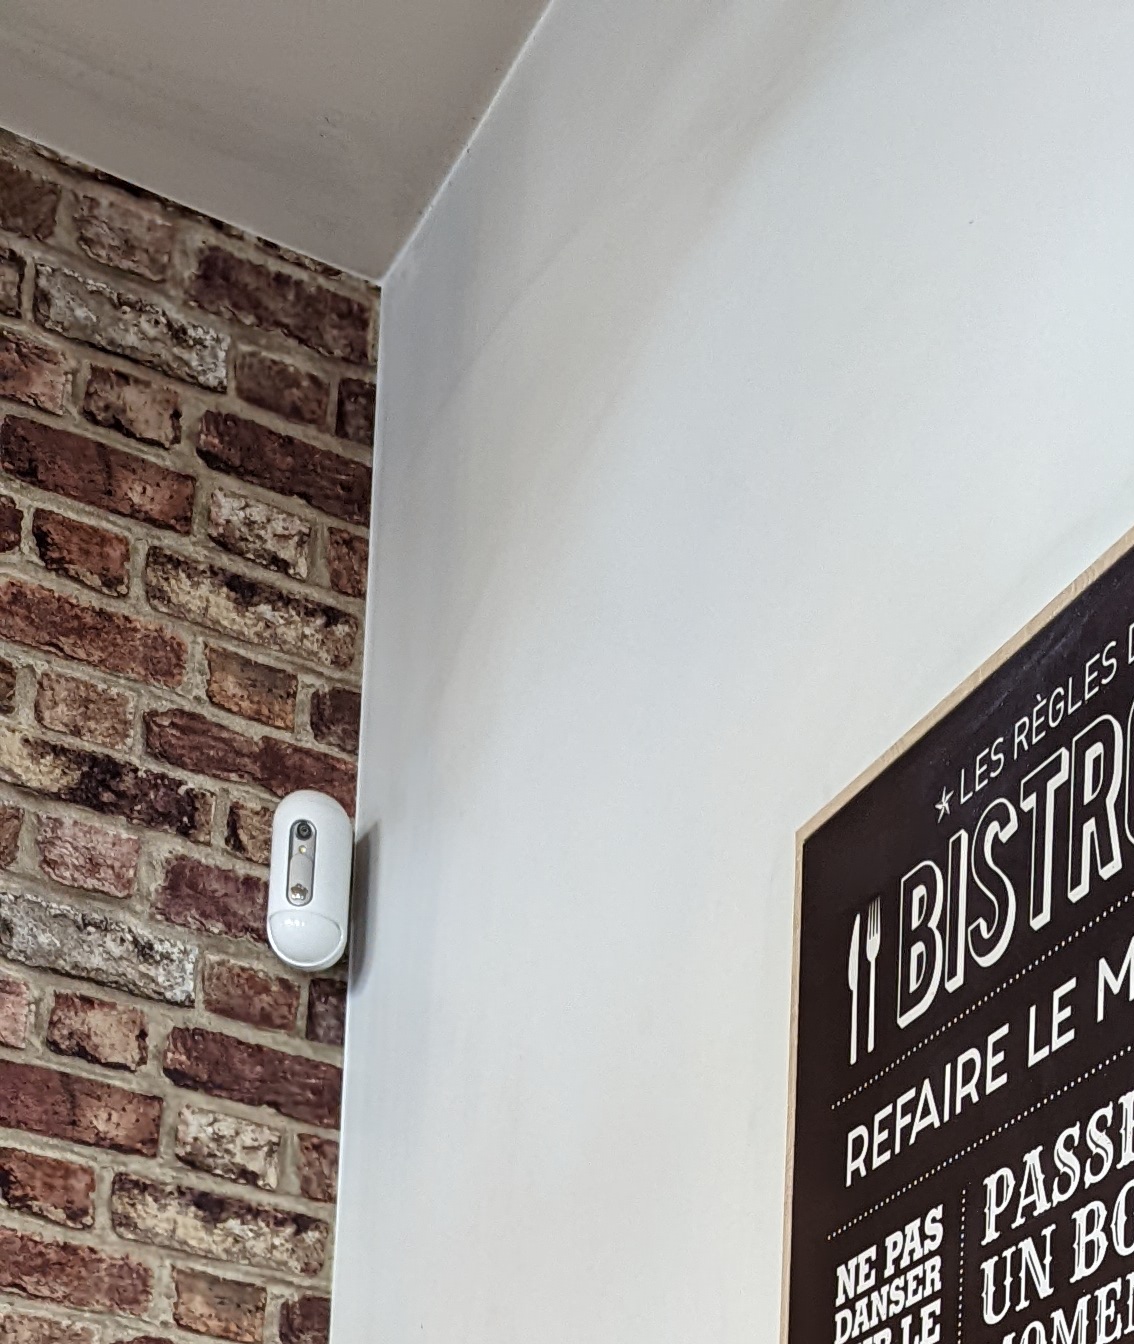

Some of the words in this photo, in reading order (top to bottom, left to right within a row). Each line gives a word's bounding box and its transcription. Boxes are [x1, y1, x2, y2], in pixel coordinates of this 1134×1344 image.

[960, 736, 1005, 805] LES
[1013, 640, 1118, 760] RÈGLES
[845, 1022, 1010, 1187] REFAIRE
[1027, 976, 1077, 1068] LE
[835, 1244, 877, 1308] NE
[883, 1204, 944, 1279] PAS
[979, 1223, 1057, 1325] UN
